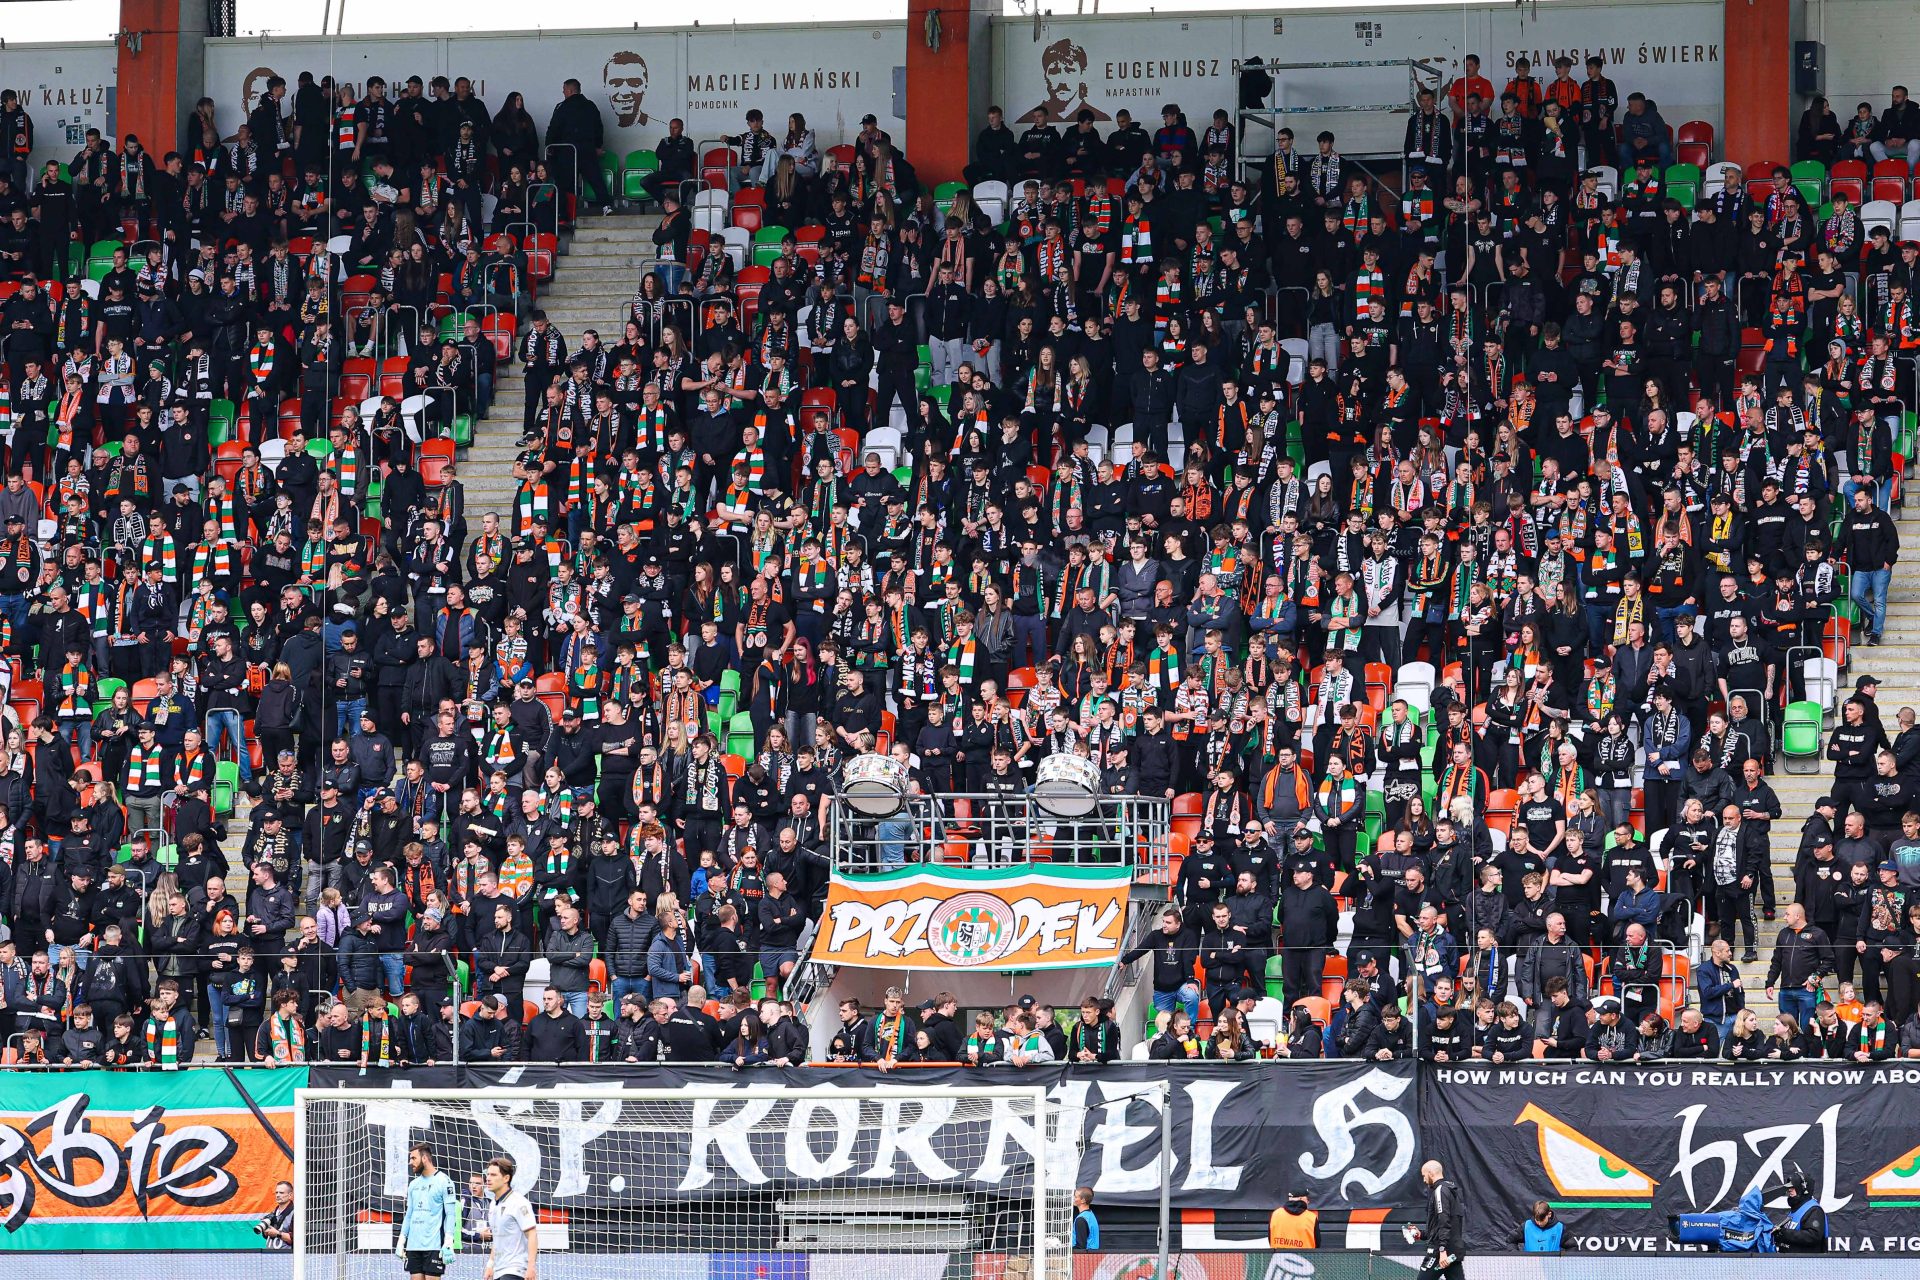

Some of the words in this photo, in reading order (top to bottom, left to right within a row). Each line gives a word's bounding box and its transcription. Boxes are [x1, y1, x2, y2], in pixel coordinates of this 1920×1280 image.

[1638, 42, 1719, 64] ŚWIERK
[688, 73, 760, 92] MACIEJ
[773, 67, 860, 90] IWAŃSKI
[1105, 59, 1219, 80] EUGENIUSZ
[43, 84, 104, 106] KAŁUŻ
[1105, 87, 1161, 97] NAPASTNIK
[688, 100, 739, 110] POMOCNIK
[1796, 470, 1809, 493] OKS
[1273, 544, 1284, 567] OKS
[1337, 536, 1349, 571] SZTAMA
[903, 655, 915, 681] MKS
[923, 658, 935, 684] OKS
[1437, 1069, 1491, 1085] HOW
[1498, 1071, 1567, 1085] MUCH
[1575, 1070, 1626, 1085] CAN
[1634, 1072, 1682, 1087] YOU
[1691, 1071, 1785, 1087] REALLY
[1793, 1070, 1865, 1085] KNOW
[677, 1080, 1244, 1192] KORNEL
[1273, 1237, 1304, 1248] STEWARD
[1573, 1236, 1657, 1252] YOU'VE
[1828, 1236, 1850, 1252] IN
[1859, 1237, 1875, 1252] A
